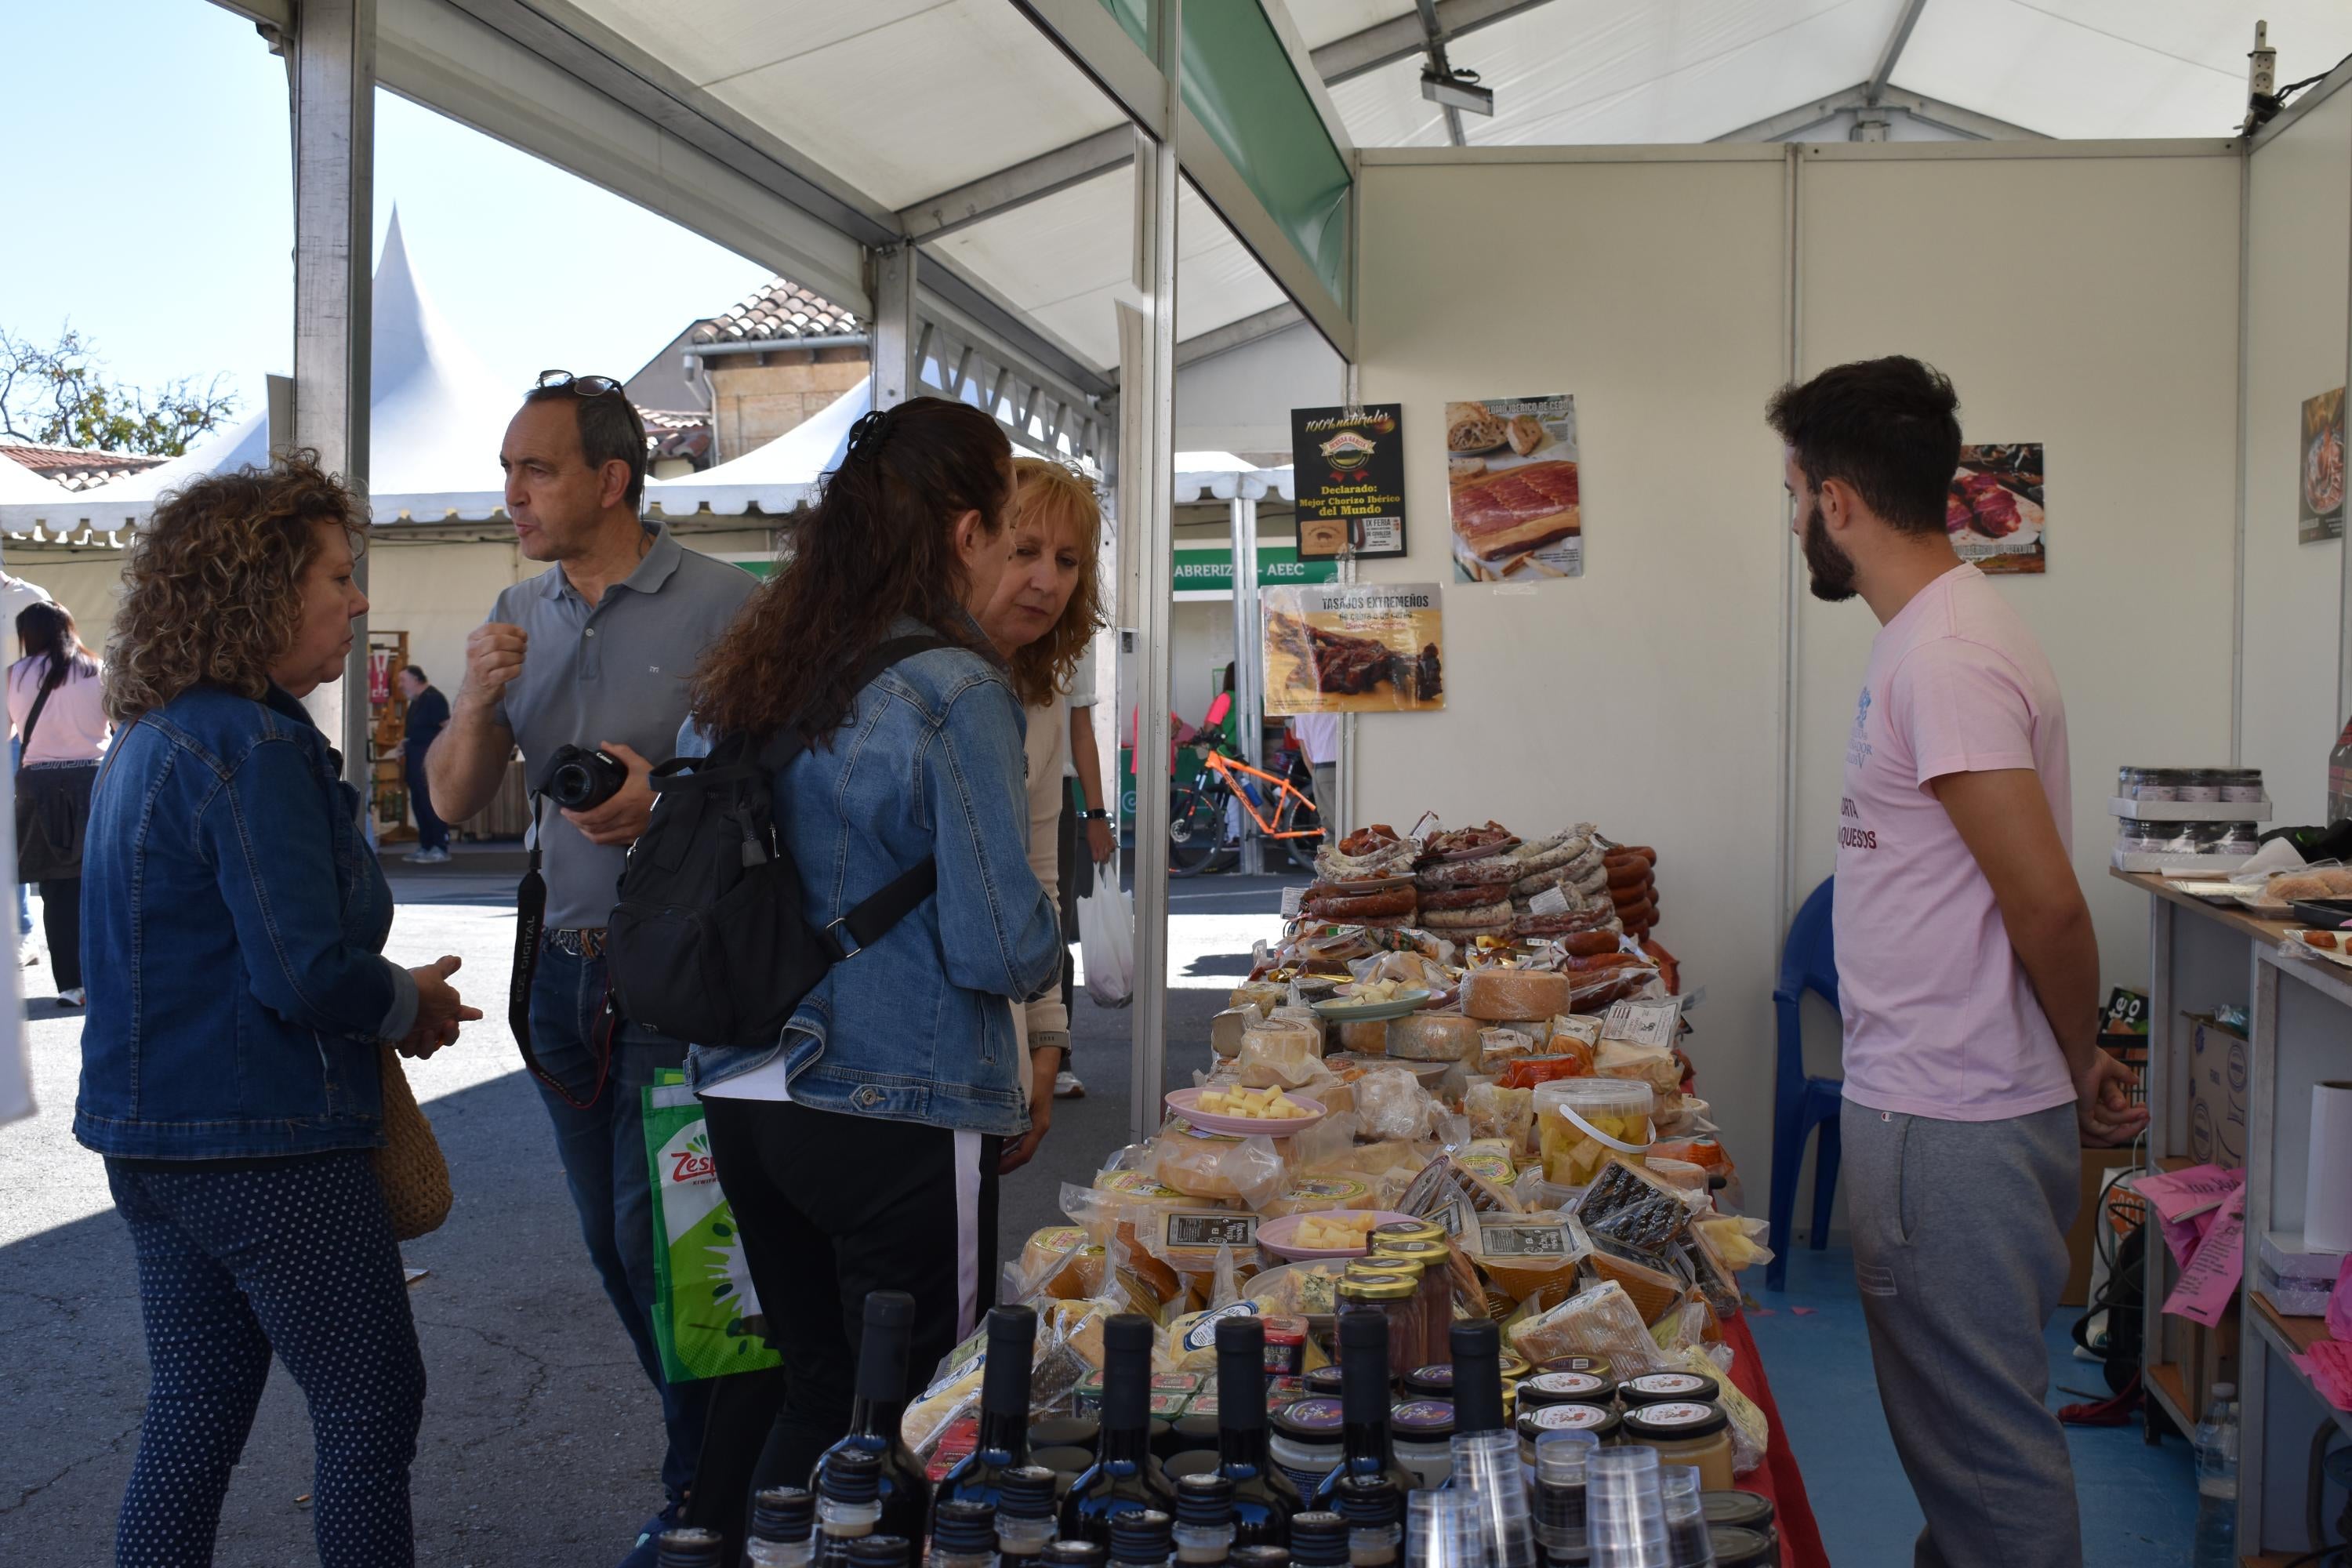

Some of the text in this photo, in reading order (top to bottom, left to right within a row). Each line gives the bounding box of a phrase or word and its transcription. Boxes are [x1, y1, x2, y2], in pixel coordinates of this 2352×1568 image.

[1320, 485, 1378, 495] Declarado:
[1299, 495, 1401, 509] Mejor Chorizo Ibérico
[1319, 504, 1382, 516] del Mundo
[1175, 564, 1233, 577] ABRERIZ
[1267, 563, 1304, 576] AEEC
[1323, 593, 1429, 610] TASAJOS EXTREMEÑOS
[1842, 797, 1859, 818] ORTA
[1842, 826, 1877, 850] QUESOS
[516, 915, 535, 1002] EOS DIGITAL
